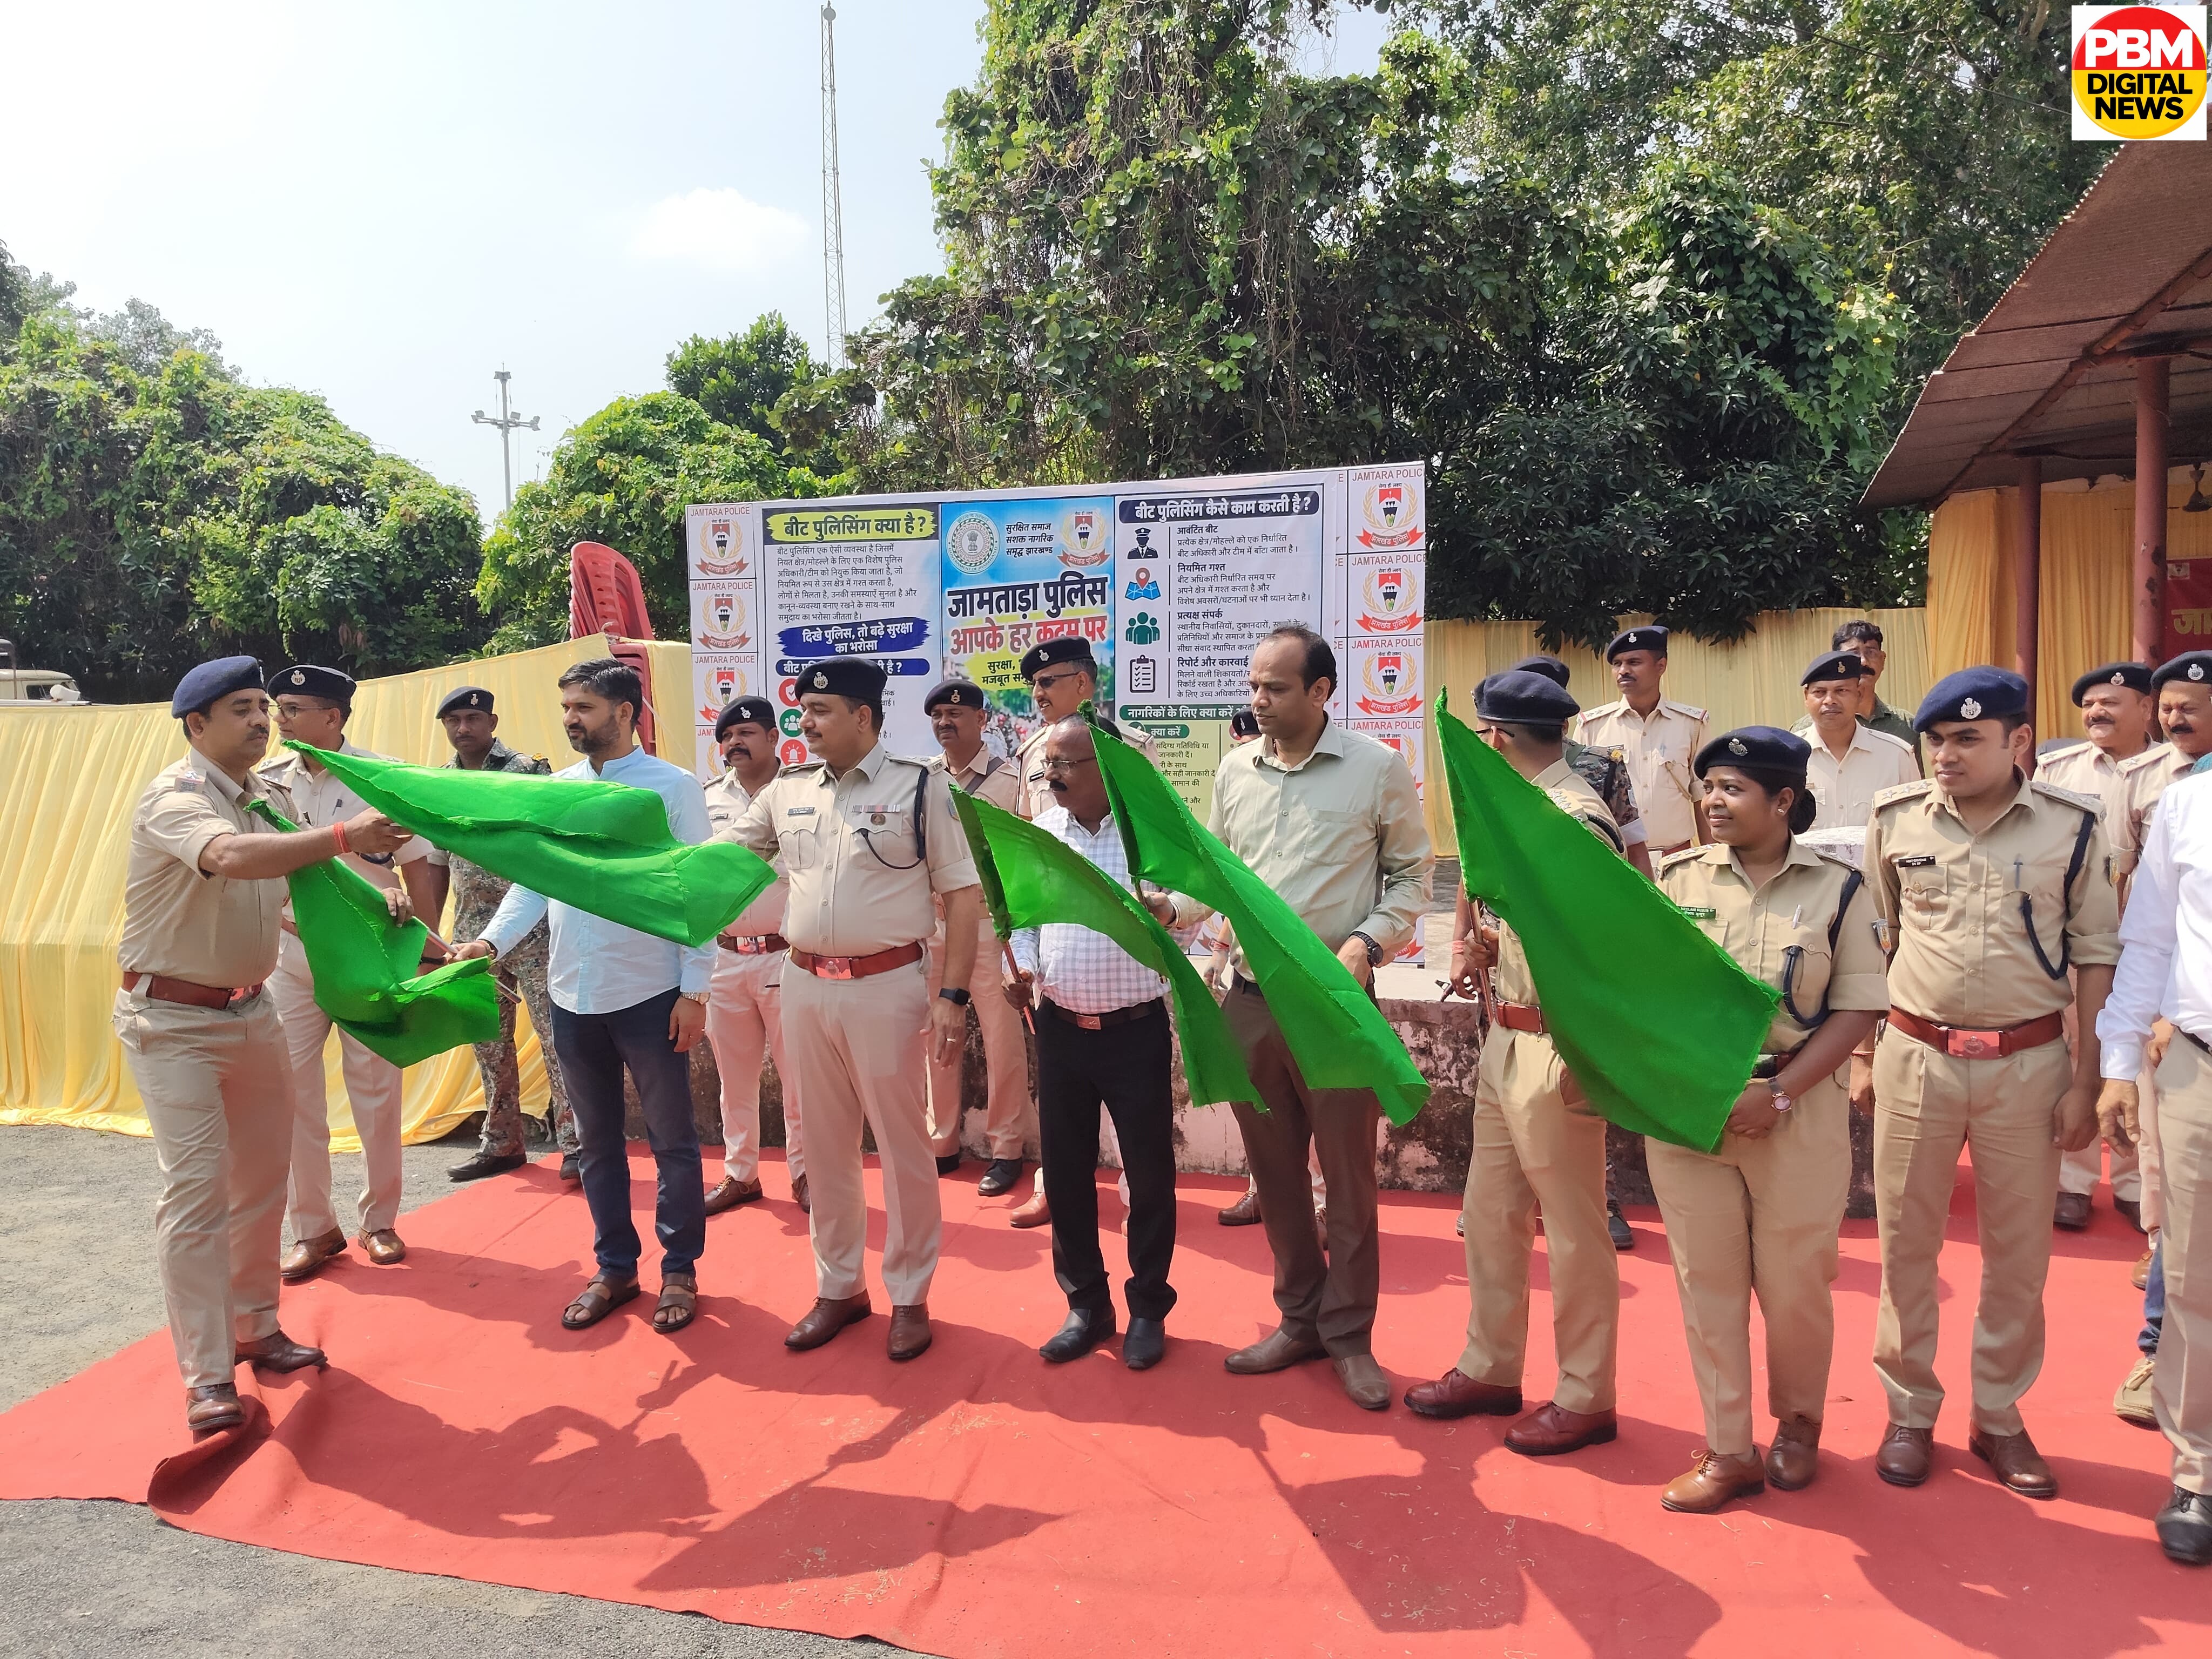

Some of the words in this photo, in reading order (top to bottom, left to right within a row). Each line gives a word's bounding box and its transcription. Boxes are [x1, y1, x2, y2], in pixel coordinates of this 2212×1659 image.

[1352, 471, 1394, 482] JAMTARA
[1397, 469, 1424, 478] POLIC
[691, 508, 723, 516] JAMTARA
[725, 507, 750, 515] POLICE
[1135, 501, 1155, 518] बीट
[1157, 500, 1203, 522] पुलिसिंग
[1206, 498, 1228, 516] कैसे
[1231, 500, 1256, 514] काम
[1258, 495, 1290, 512] करती
[784, 516, 809, 536] बीट
[813, 515, 871, 540] पुलिसिंग
[874, 518, 901, 532] क्या
[1006, 522, 1029, 534] सुरक्षित
[1031, 523, 1051, 534] समाज
[1205, 524, 1218, 532] बीट
[1006, 534, 1026, 543] सशक्त
[1028, 533, 1054, 542] नागरिक
[1177, 537, 1196, 545] प्रत्येक
[1198, 536, 1234, 545] क्षेत्र/मोहल्ले
[1236, 535, 1245, 543] को
[1262, 533, 1287, 542] निर्धारित
[1371, 535, 1392, 545] झारखंड
[1393, 533, 1408, 545] पुलिस
[790, 546, 814, 556] पुलिसिंग
[830, 545, 841, 554] ऐसी
[868, 544, 873, 553] है
[875, 543, 894, 551] जिसमें
[1006, 548, 1023, 557] समृद्ध
[1177, 549, 1189, 557] बीट
[1190, 548, 1217, 556] अधिकारी
[1218, 547, 1231, 555] और
[1233, 547, 1244, 555] टीम
[778, 557, 794, 565] नियत
[795, 557, 828, 565] क्षेत्र/मोहल्ले
[838, 556, 850, 564] लिए
[865, 555, 882, 563] विशेष
[884, 555, 902, 565] पुलिस
[1352, 556, 1393, 566] JAMTARA
[1177, 562, 1206, 571] नियमित
[778, 568, 818, 577] अधिकारी/टीम
[820, 568, 828, 576] को
[831, 568, 849, 578] नियुक्त
[1190, 574, 1218, 582] अधिकारी
[1220, 573, 1245, 581] निर्धारित
[728, 582, 752, 590] POLICE
[947, 583, 1040, 619] जामताड़ा
[1043, 571, 1108, 618] पुलिस
[778, 603, 820, 611] कानून-व्यवस्था
[778, 614, 800, 623] समुदाय
[812, 612, 831, 620] भरोसा
[832, 612, 852, 621] जीतता
[1202, 609, 1222, 618] संपर्क
[1236, 621, 1270, 631] दुकानदारों,
[1371, 619, 1391, 629] झारखंड
[1392, 618, 1408, 630] पुलिस
[802, 628, 822, 642] दिखे
[824, 626, 854, 640] पुलिस,
[857, 624, 868, 637] तो
[869, 623, 885, 638] बढ़े
[886, 623, 913, 638] सुरक्षा
[950, 617, 1004, 655] आपके
[1009, 623, 1033, 653] हर
[1083, 616, 1107, 642] पर
[1177, 632, 1209, 640] प्रतिनिधियों
[1225, 631, 1245, 639] समाज
[834, 643, 848, 653] का
[849, 640, 878, 651] भरोसा
[1352, 640, 1393, 649] JAMTARA
[1395, 638, 1423, 647] POLIC
[1177, 657, 1198, 666] रिपोर्ट
[1201, 656, 1216, 666] और
[1218, 656, 1249, 666] कारवाई
[784, 662, 799, 673] बीट
[987, 660, 1015, 673] सुरक्षा,
[1177, 670, 1195, 679] मिलने
[982, 674, 1010, 686] मजबूत
[1185, 690, 1197, 698] लिए
[1128, 706, 1165, 717] नागरिकों
[1167, 706, 1176, 717] के
[1179, 706, 1197, 718] लिए
[1199, 709, 1216, 717] क्या
[1218, 704, 1232, 717] करें
[1371, 702, 1391, 711] झारखंड
[1392, 701, 1408, 712] पुलिस
[1351, 721, 1392, 730] JAMTARA
[1395, 720, 1423, 730] POLIC
[1168, 726, 1181, 736] करें
